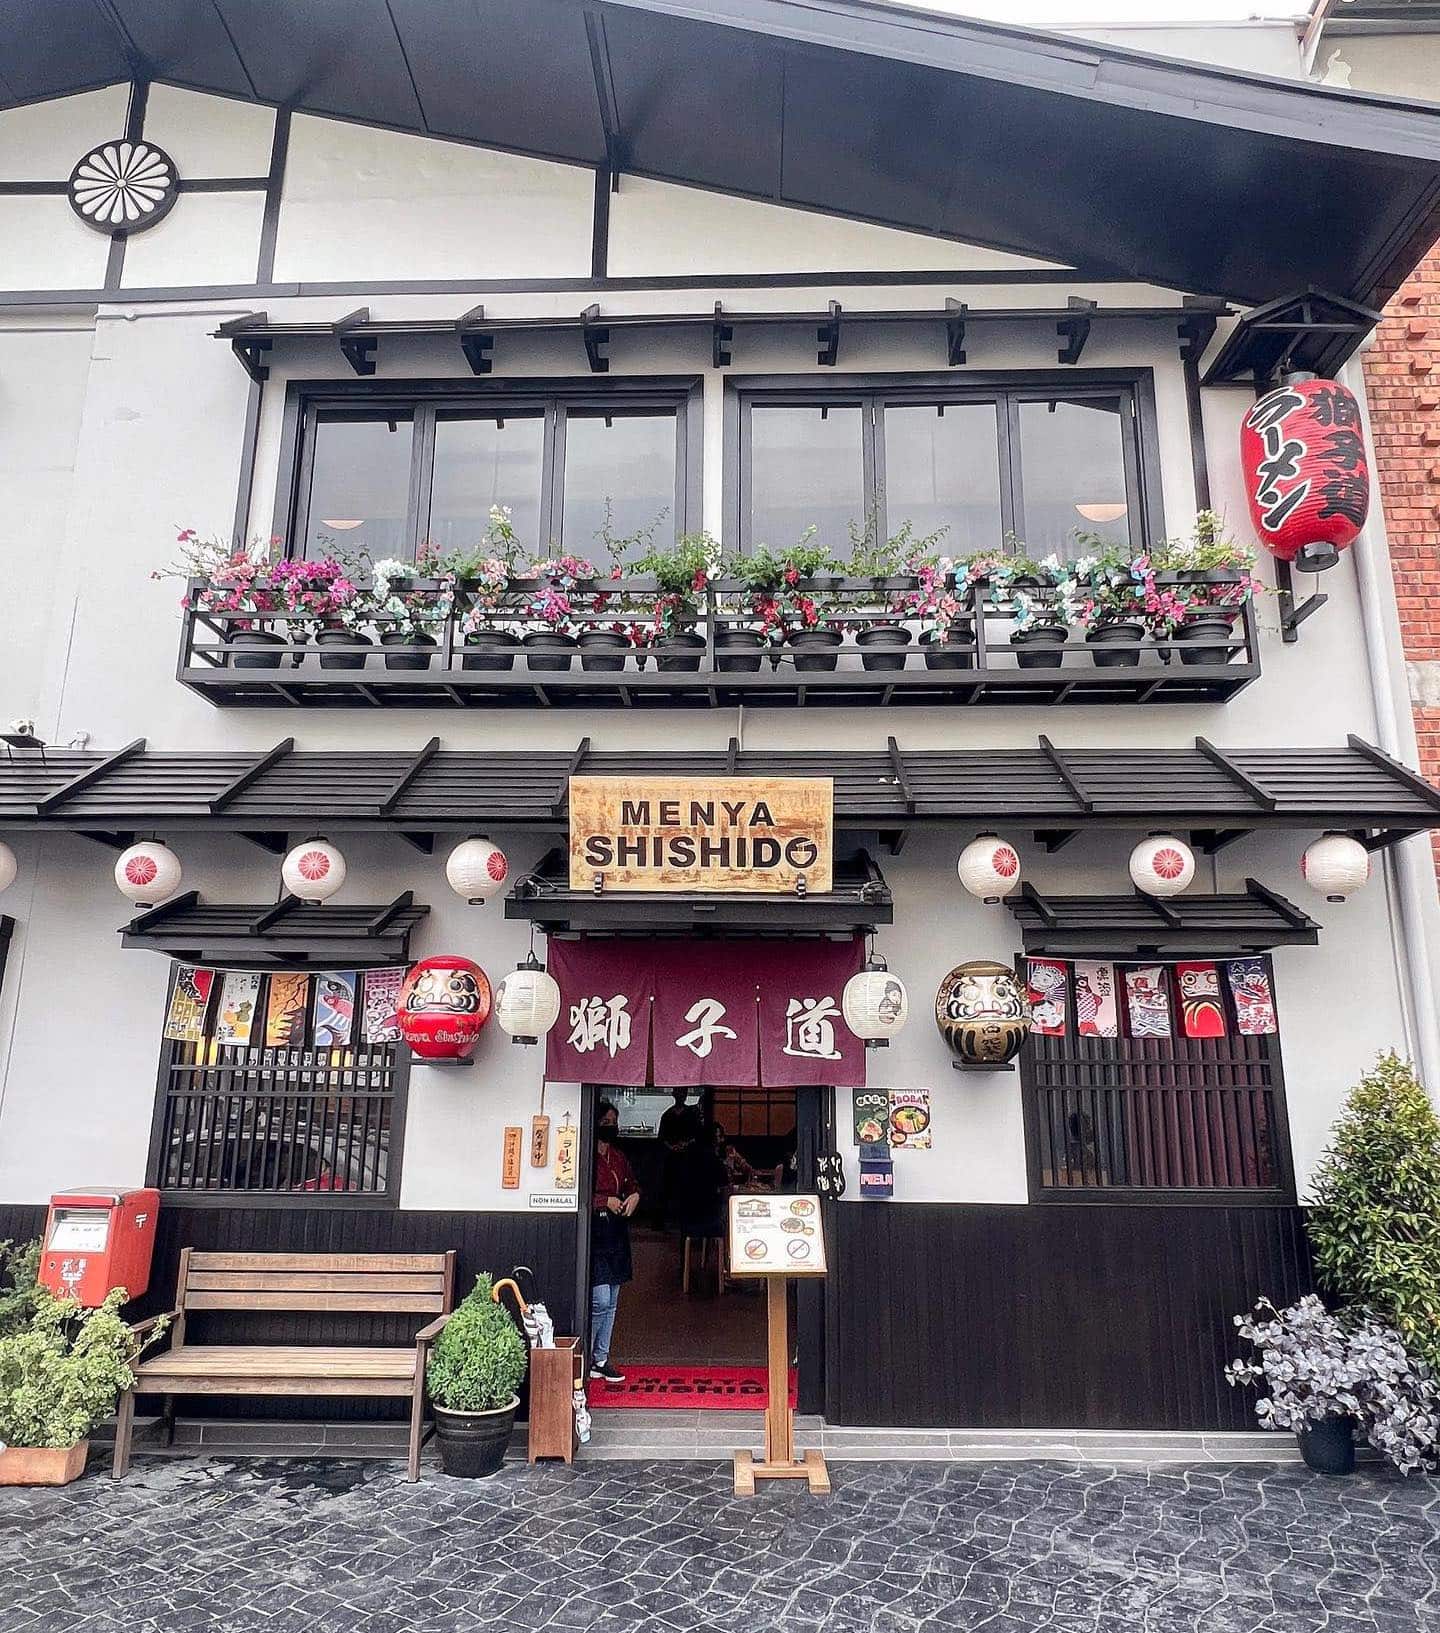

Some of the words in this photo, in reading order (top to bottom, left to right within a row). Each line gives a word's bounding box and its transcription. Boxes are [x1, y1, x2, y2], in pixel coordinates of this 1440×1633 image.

[1247, 386, 1312, 532] ラーメン
[621, 800, 775, 826] MENYA
[585, 836, 818, 868] SHISHIDO
[566, 994, 844, 1060] 獅子道
[562, 1140, 572, 1173] ラーメン
[604, 1383, 792, 1394] SHISHID
